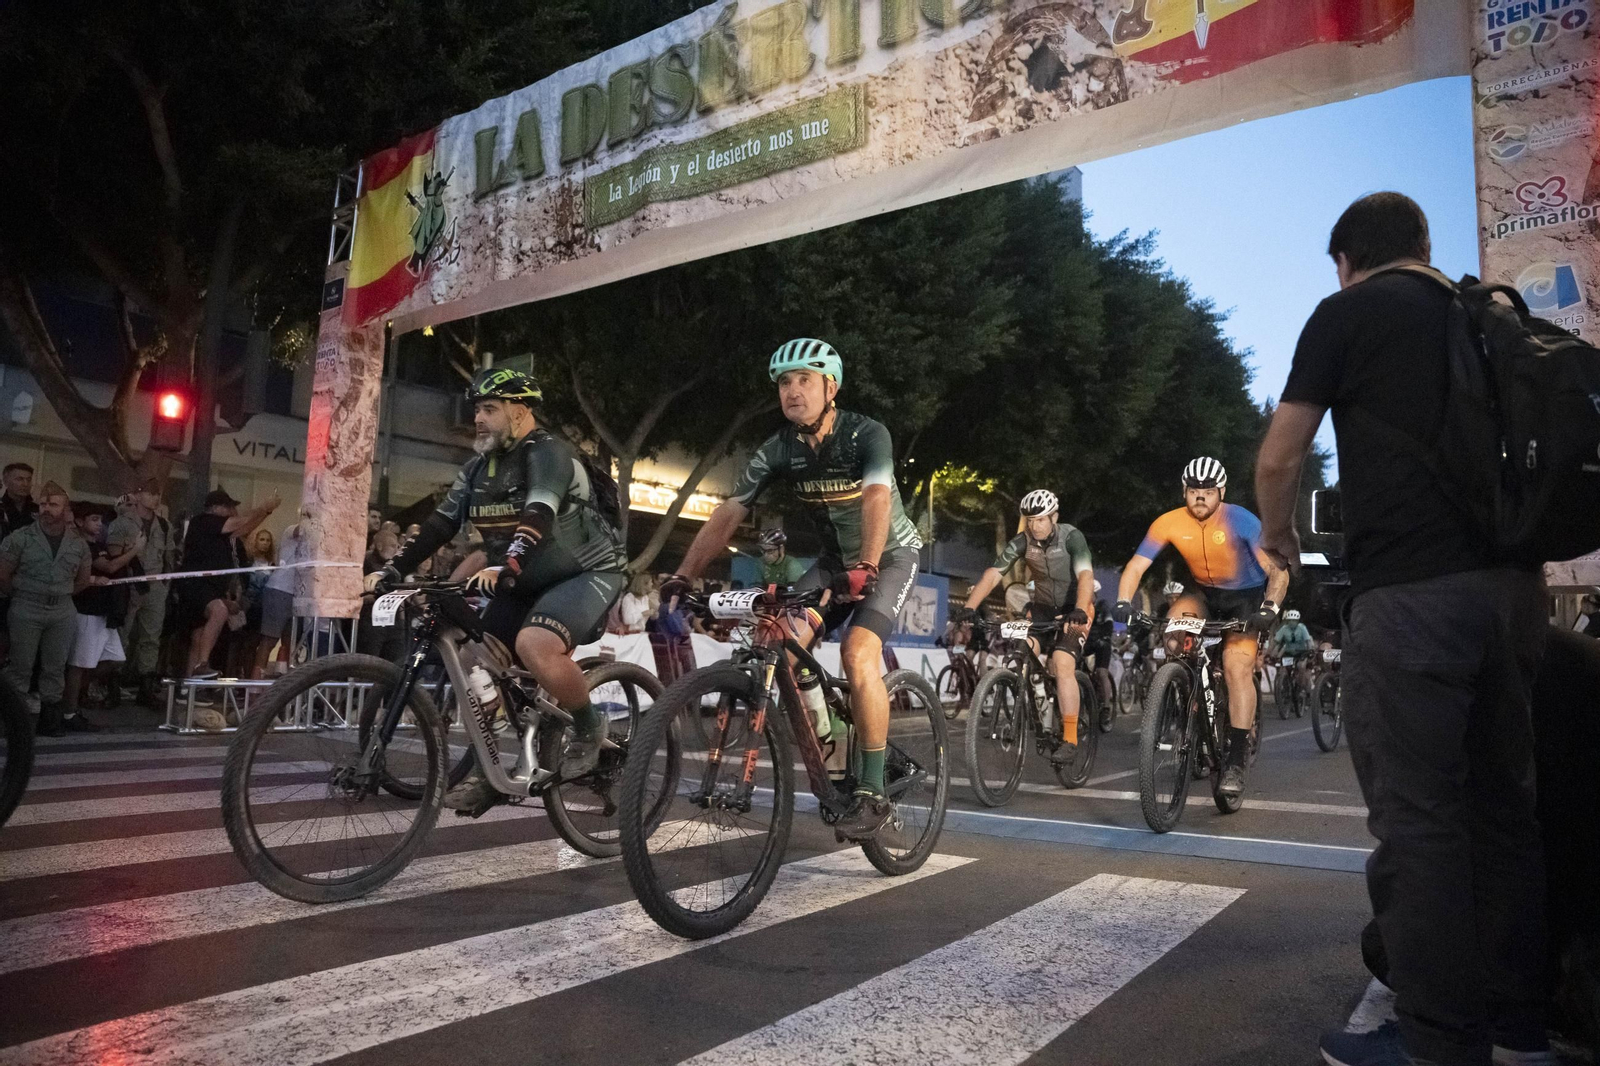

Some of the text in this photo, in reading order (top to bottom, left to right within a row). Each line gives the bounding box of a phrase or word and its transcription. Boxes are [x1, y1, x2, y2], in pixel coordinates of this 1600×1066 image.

[1487, 8, 1588, 53] TODO
[474, 109, 546, 200] LA
[608, 117, 830, 203] La Legión y el desierto nos une
[1496, 205, 1600, 239] primaflor
[466, 688, 500, 766] cannondale
